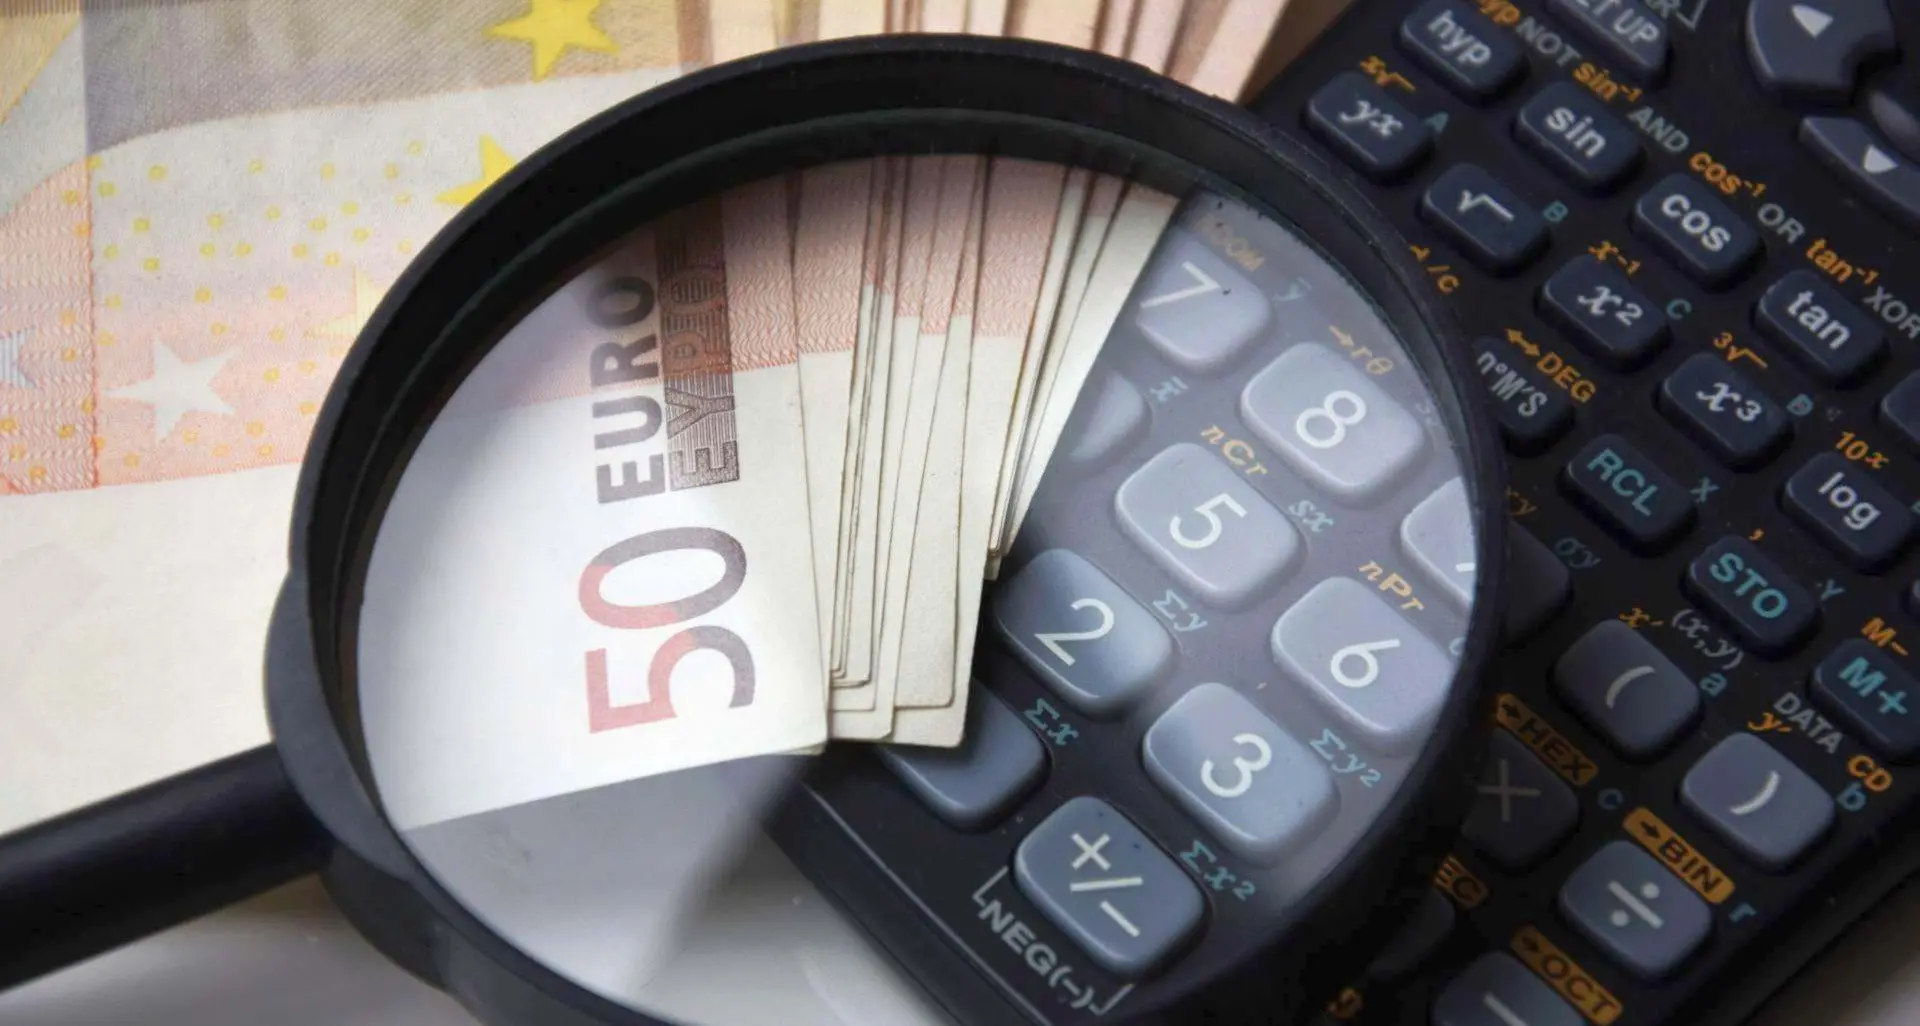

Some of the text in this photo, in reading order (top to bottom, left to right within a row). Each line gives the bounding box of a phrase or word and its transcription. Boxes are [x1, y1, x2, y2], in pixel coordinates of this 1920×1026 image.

[1427, 9, 1491, 65] hyp
[1516, 16, 1581, 67] NOT
[1545, 106, 1606, 158] sin
[1627, 106, 1690, 152] AND
[1661, 193, 1731, 252] cos
[1756, 202, 1805, 244] OR
[1140, 261, 1222, 309] 7
[1862, 285, 1920, 340] XOR
[1786, 290, 1851, 350] tan
[585, 274, 668, 504] EURO
[1536, 351, 1597, 403] DEG
[1296, 390, 1367, 449] 8
[1200, 424, 1268, 478] nCr
[1587, 448, 1661, 518] RCL
[1816, 472, 1882, 531] log
[1169, 492, 1249, 549] 5
[1357, 560, 1425, 613] nPr
[1709, 552, 1788, 619] STO
[578, 526, 757, 735] 50
[1034, 597, 1115, 667] 2
[1329, 637, 1401, 688] 6
[1838, 656, 1909, 716] M+
[1518, 716, 1598, 782] HEX
[1773, 691, 1844, 754] DATA
[1201, 733, 1272, 798] 3
[1658, 836, 1723, 894] BIN
